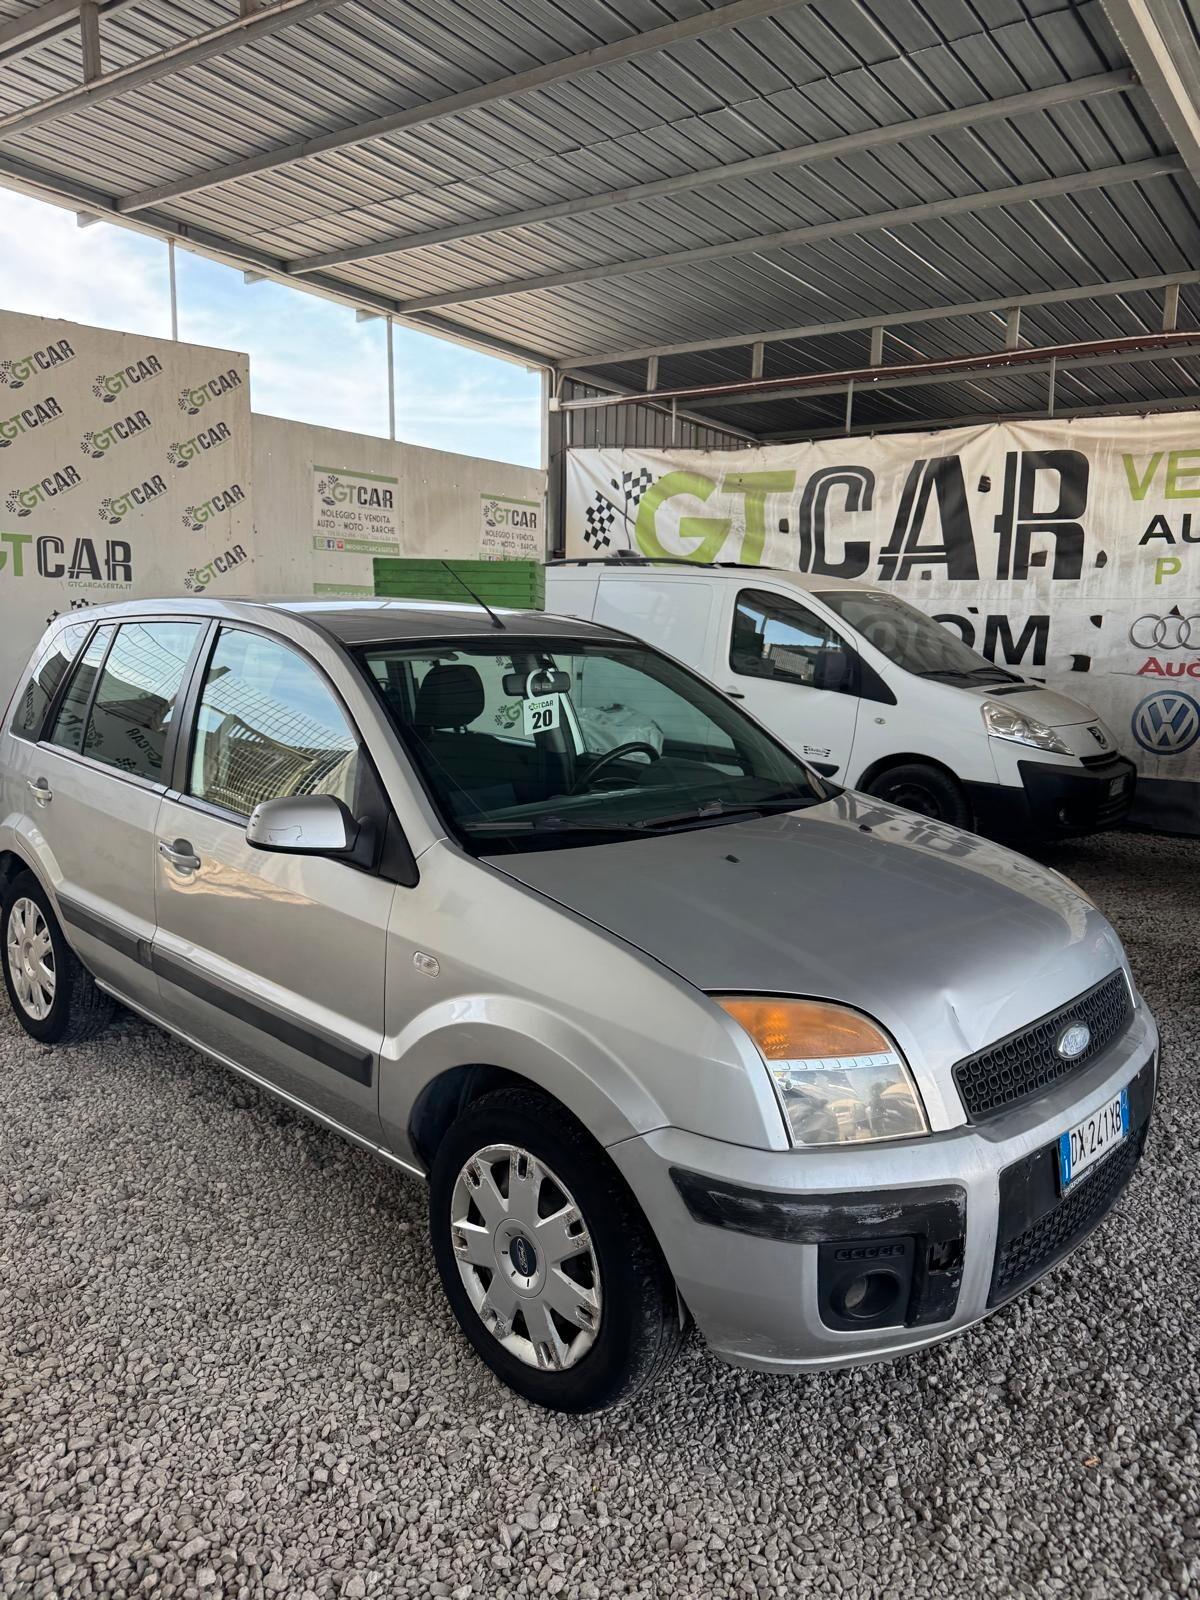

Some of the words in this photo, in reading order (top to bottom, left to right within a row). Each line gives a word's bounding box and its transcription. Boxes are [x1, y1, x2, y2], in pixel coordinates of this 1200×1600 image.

[11, 339, 76, 380] GTCAR
[104, 354, 163, 394] GTCAR
[188, 368, 242, 407] GTCAR
[0, 396, 63, 439] GTCAR
[93, 409, 152, 450] GTCAR
[177, 421, 232, 460] GTCAR
[19, 465, 82, 509] GTCAR
[110, 474, 167, 516] GTCAR
[192, 484, 246, 523] GTCAR
[332, 482, 393, 509] GTCAR
[317, 519, 336, 528] AUTO
[343, 522, 364, 531] MOTO
[371, 525, 396, 534] BARCHE
[321, 509, 356, 520] NOLEGGIO
[364, 513, 391, 524] VENDITA
[493, 506, 537, 529] GTCAR
[0, 533, 132, 581] TCAR
[195, 544, 248, 585] GTCAR
[1154, 557, 1182, 585] P
[532, 709, 552, 729] 20
[533, 700, 553, 709] GTCAR
[1071, 1125, 1086, 1167] DX
[1088, 1100, 1121, 1154] 241XB
